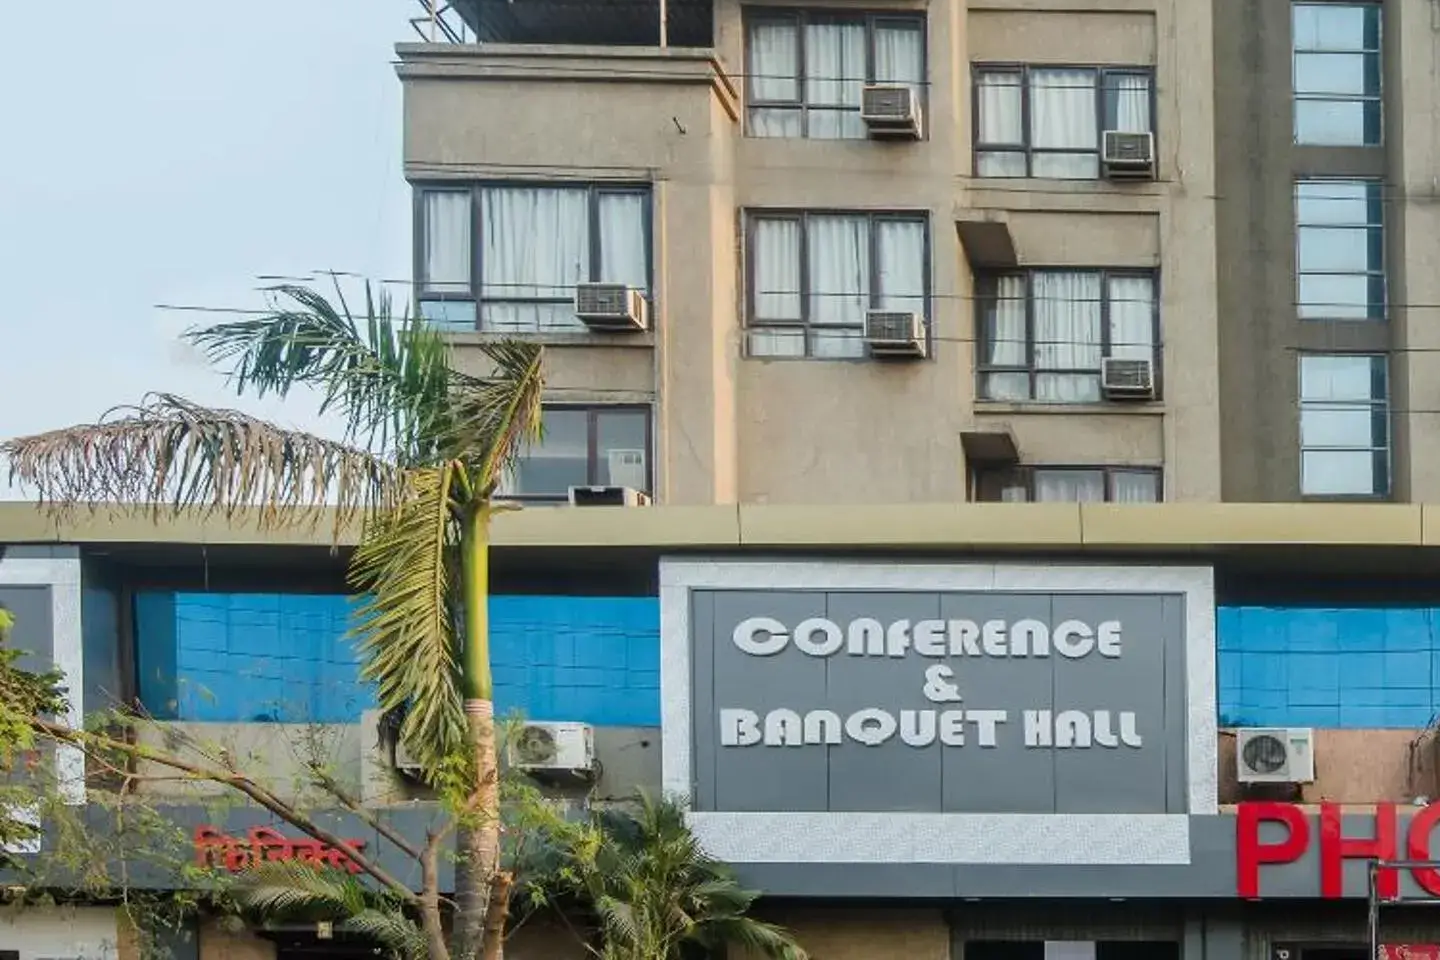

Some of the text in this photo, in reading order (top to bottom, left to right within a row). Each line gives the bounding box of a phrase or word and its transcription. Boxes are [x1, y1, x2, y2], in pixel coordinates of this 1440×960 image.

[732, 616, 1122, 658] CONFERENCE
[922, 663, 962, 703] &
[719, 707, 1142, 748] BANQUET HALL
